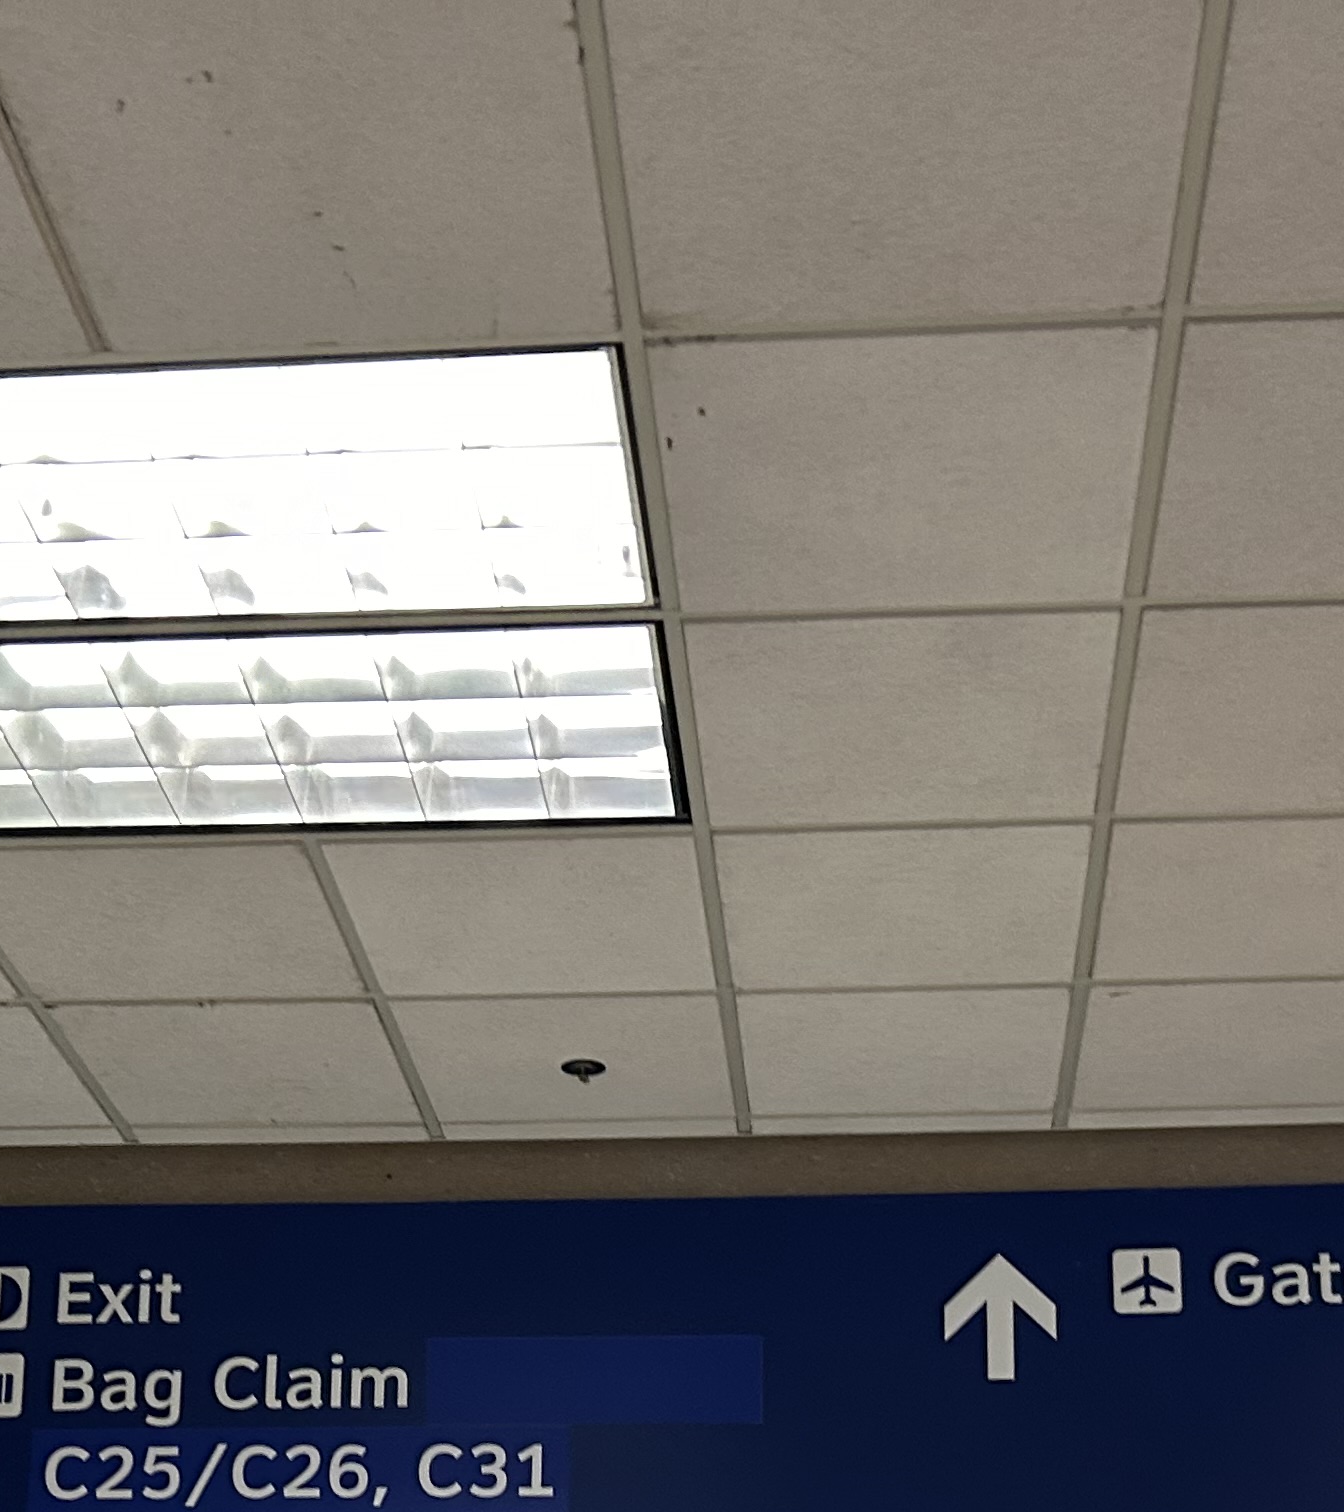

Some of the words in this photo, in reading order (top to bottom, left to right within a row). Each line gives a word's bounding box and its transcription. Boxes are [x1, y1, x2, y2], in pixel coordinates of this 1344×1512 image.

[56, 1269, 182, 1324] Exit
[51, 1358, 183, 1427] Bag
[214, 1353, 408, 1411] Claim
[44, 1443, 388, 1508] C25/C26,
[418, 1442, 554, 1498] C31
